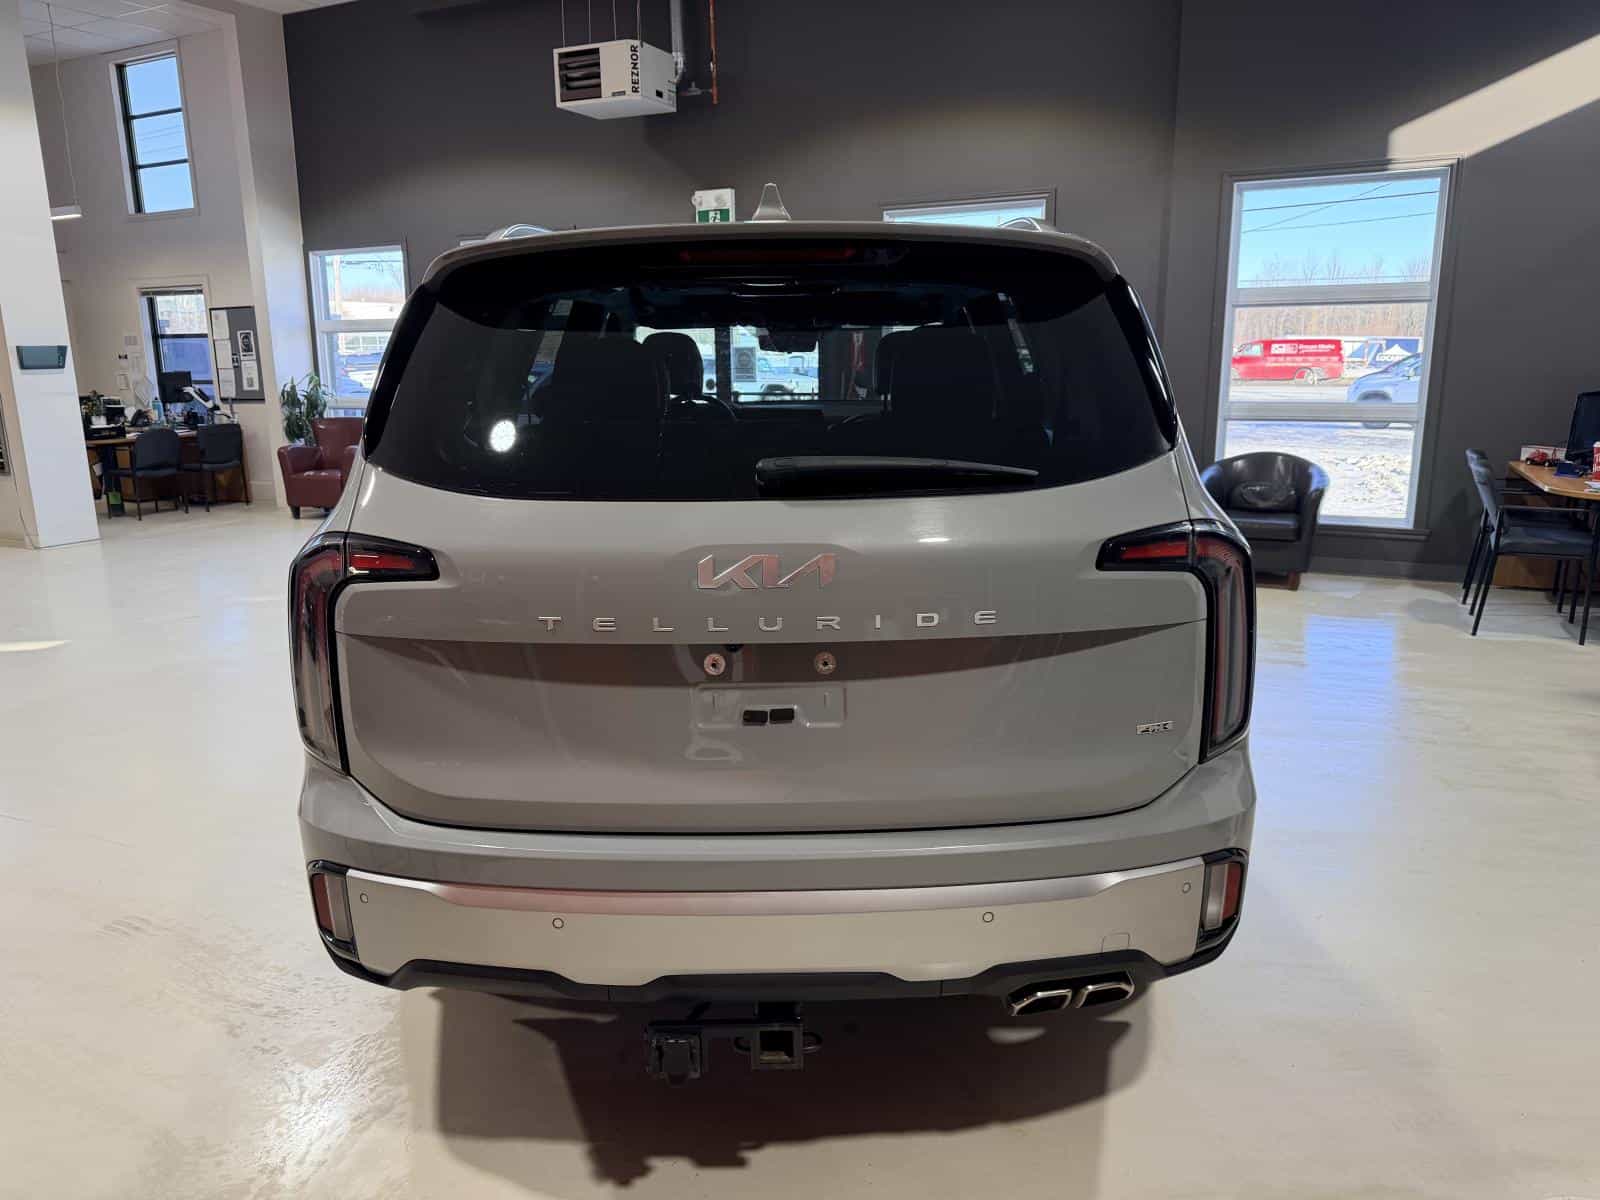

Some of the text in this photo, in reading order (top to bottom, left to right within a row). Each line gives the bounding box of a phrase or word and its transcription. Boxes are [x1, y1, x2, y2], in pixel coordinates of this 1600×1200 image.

[630, 44, 641, 94] REZNOR
[697, 553, 836, 590] KIA
[537, 609, 998, 633] TELLURIDE
